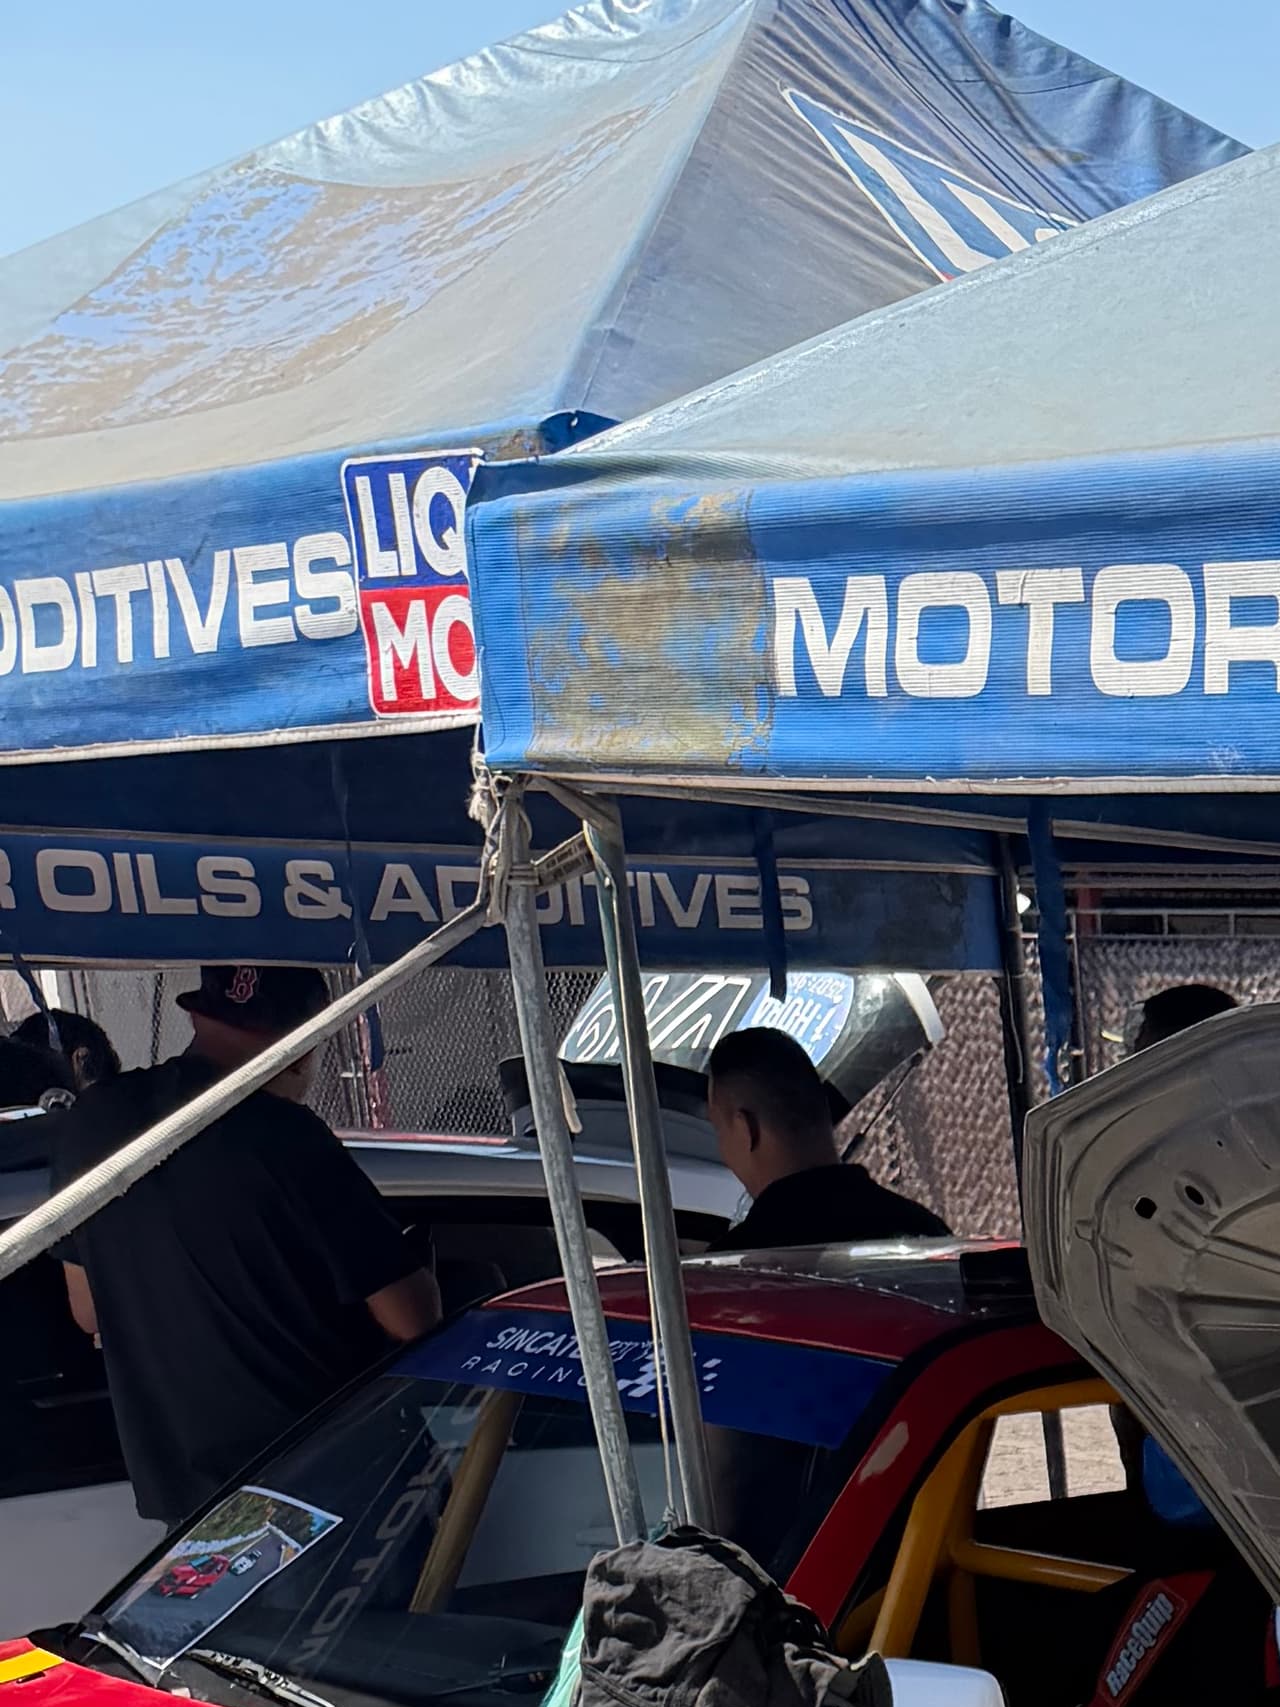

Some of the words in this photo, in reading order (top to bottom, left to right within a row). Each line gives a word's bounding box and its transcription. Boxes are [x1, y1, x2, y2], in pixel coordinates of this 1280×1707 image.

[356, 465, 467, 578] LIQ
[0, 531, 361, 676] DITIVES
[371, 596, 480, 702] MO
[37, 849, 262, 917] OILS
[284, 859, 352, 920] &
